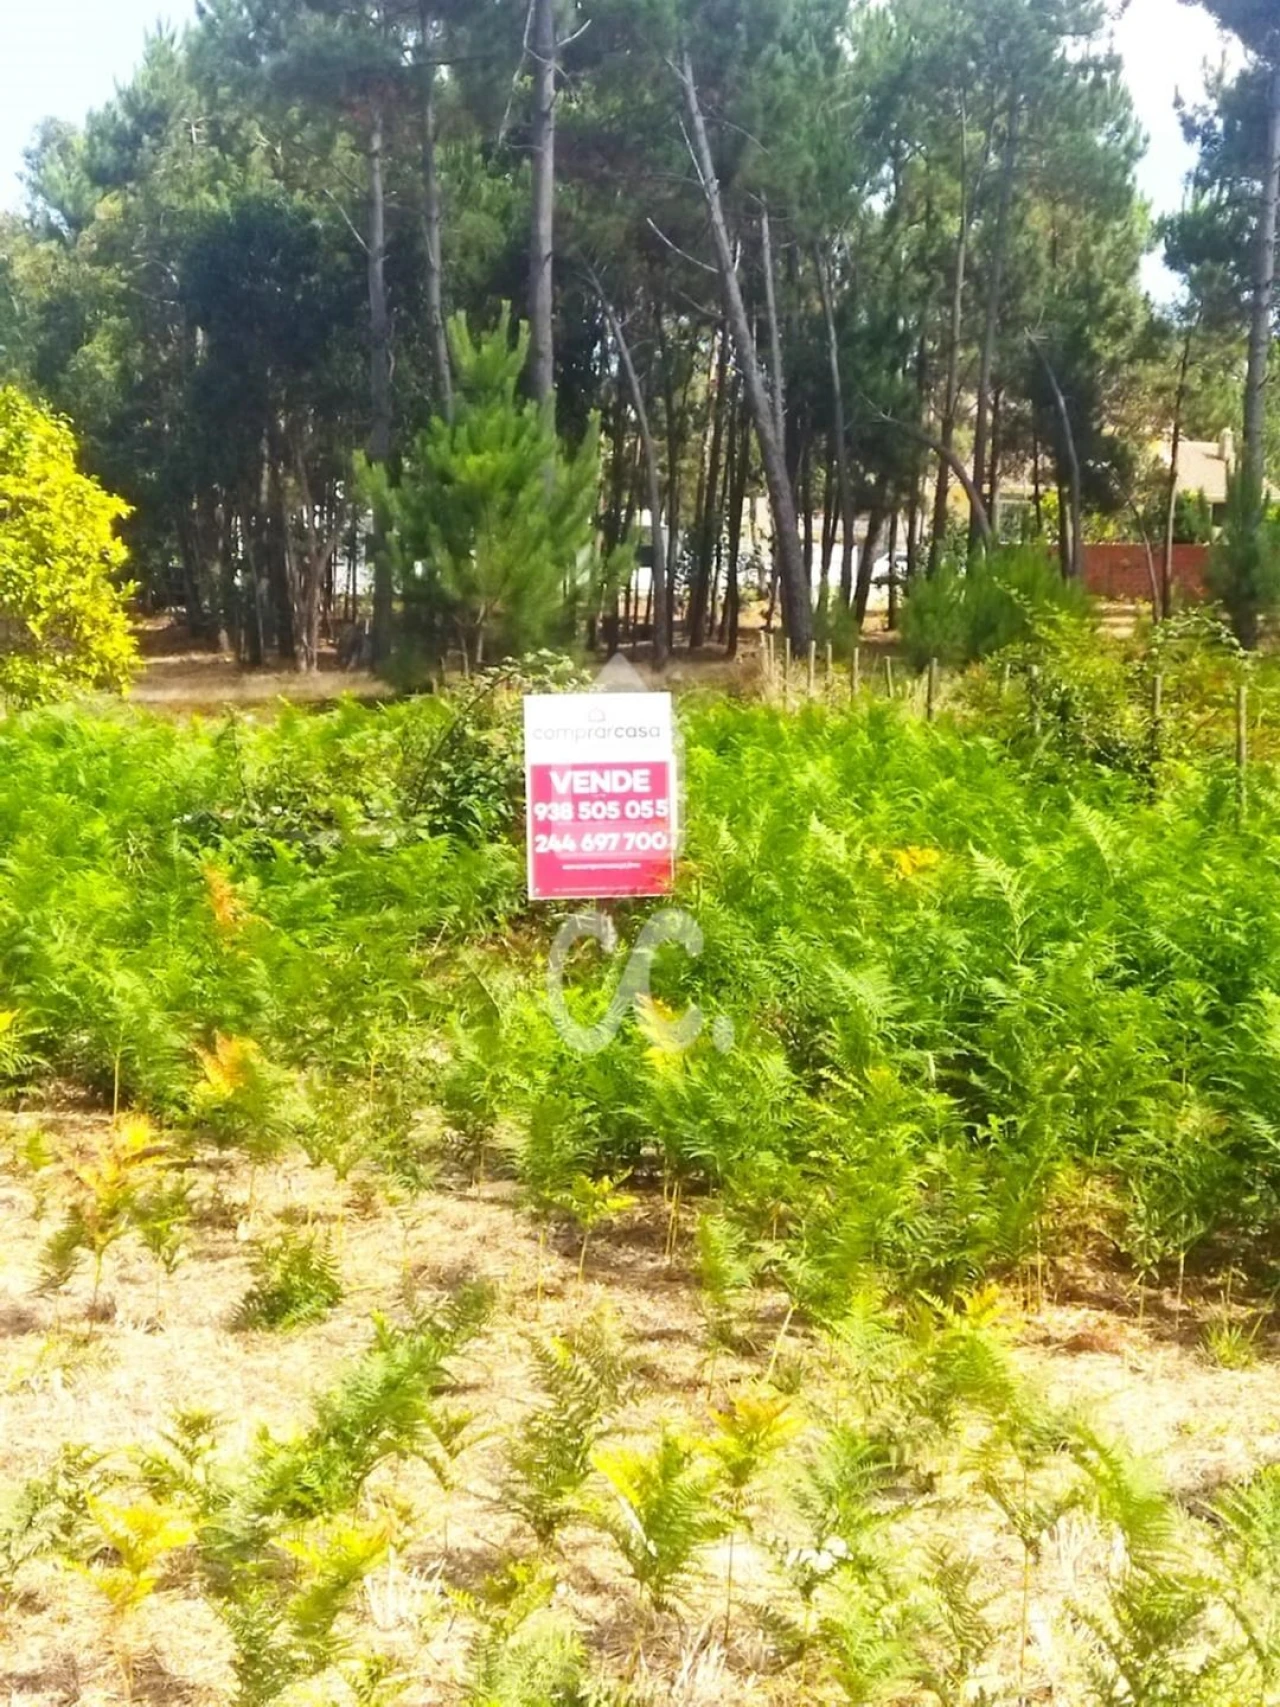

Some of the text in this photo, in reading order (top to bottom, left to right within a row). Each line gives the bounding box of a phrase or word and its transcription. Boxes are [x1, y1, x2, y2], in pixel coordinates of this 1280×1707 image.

[532, 726, 661, 744] comprarcasa
[549, 769, 650, 794] VENDE
[533, 799, 669, 821] 938 505 055
[535, 831, 667, 852] 244 697 700
